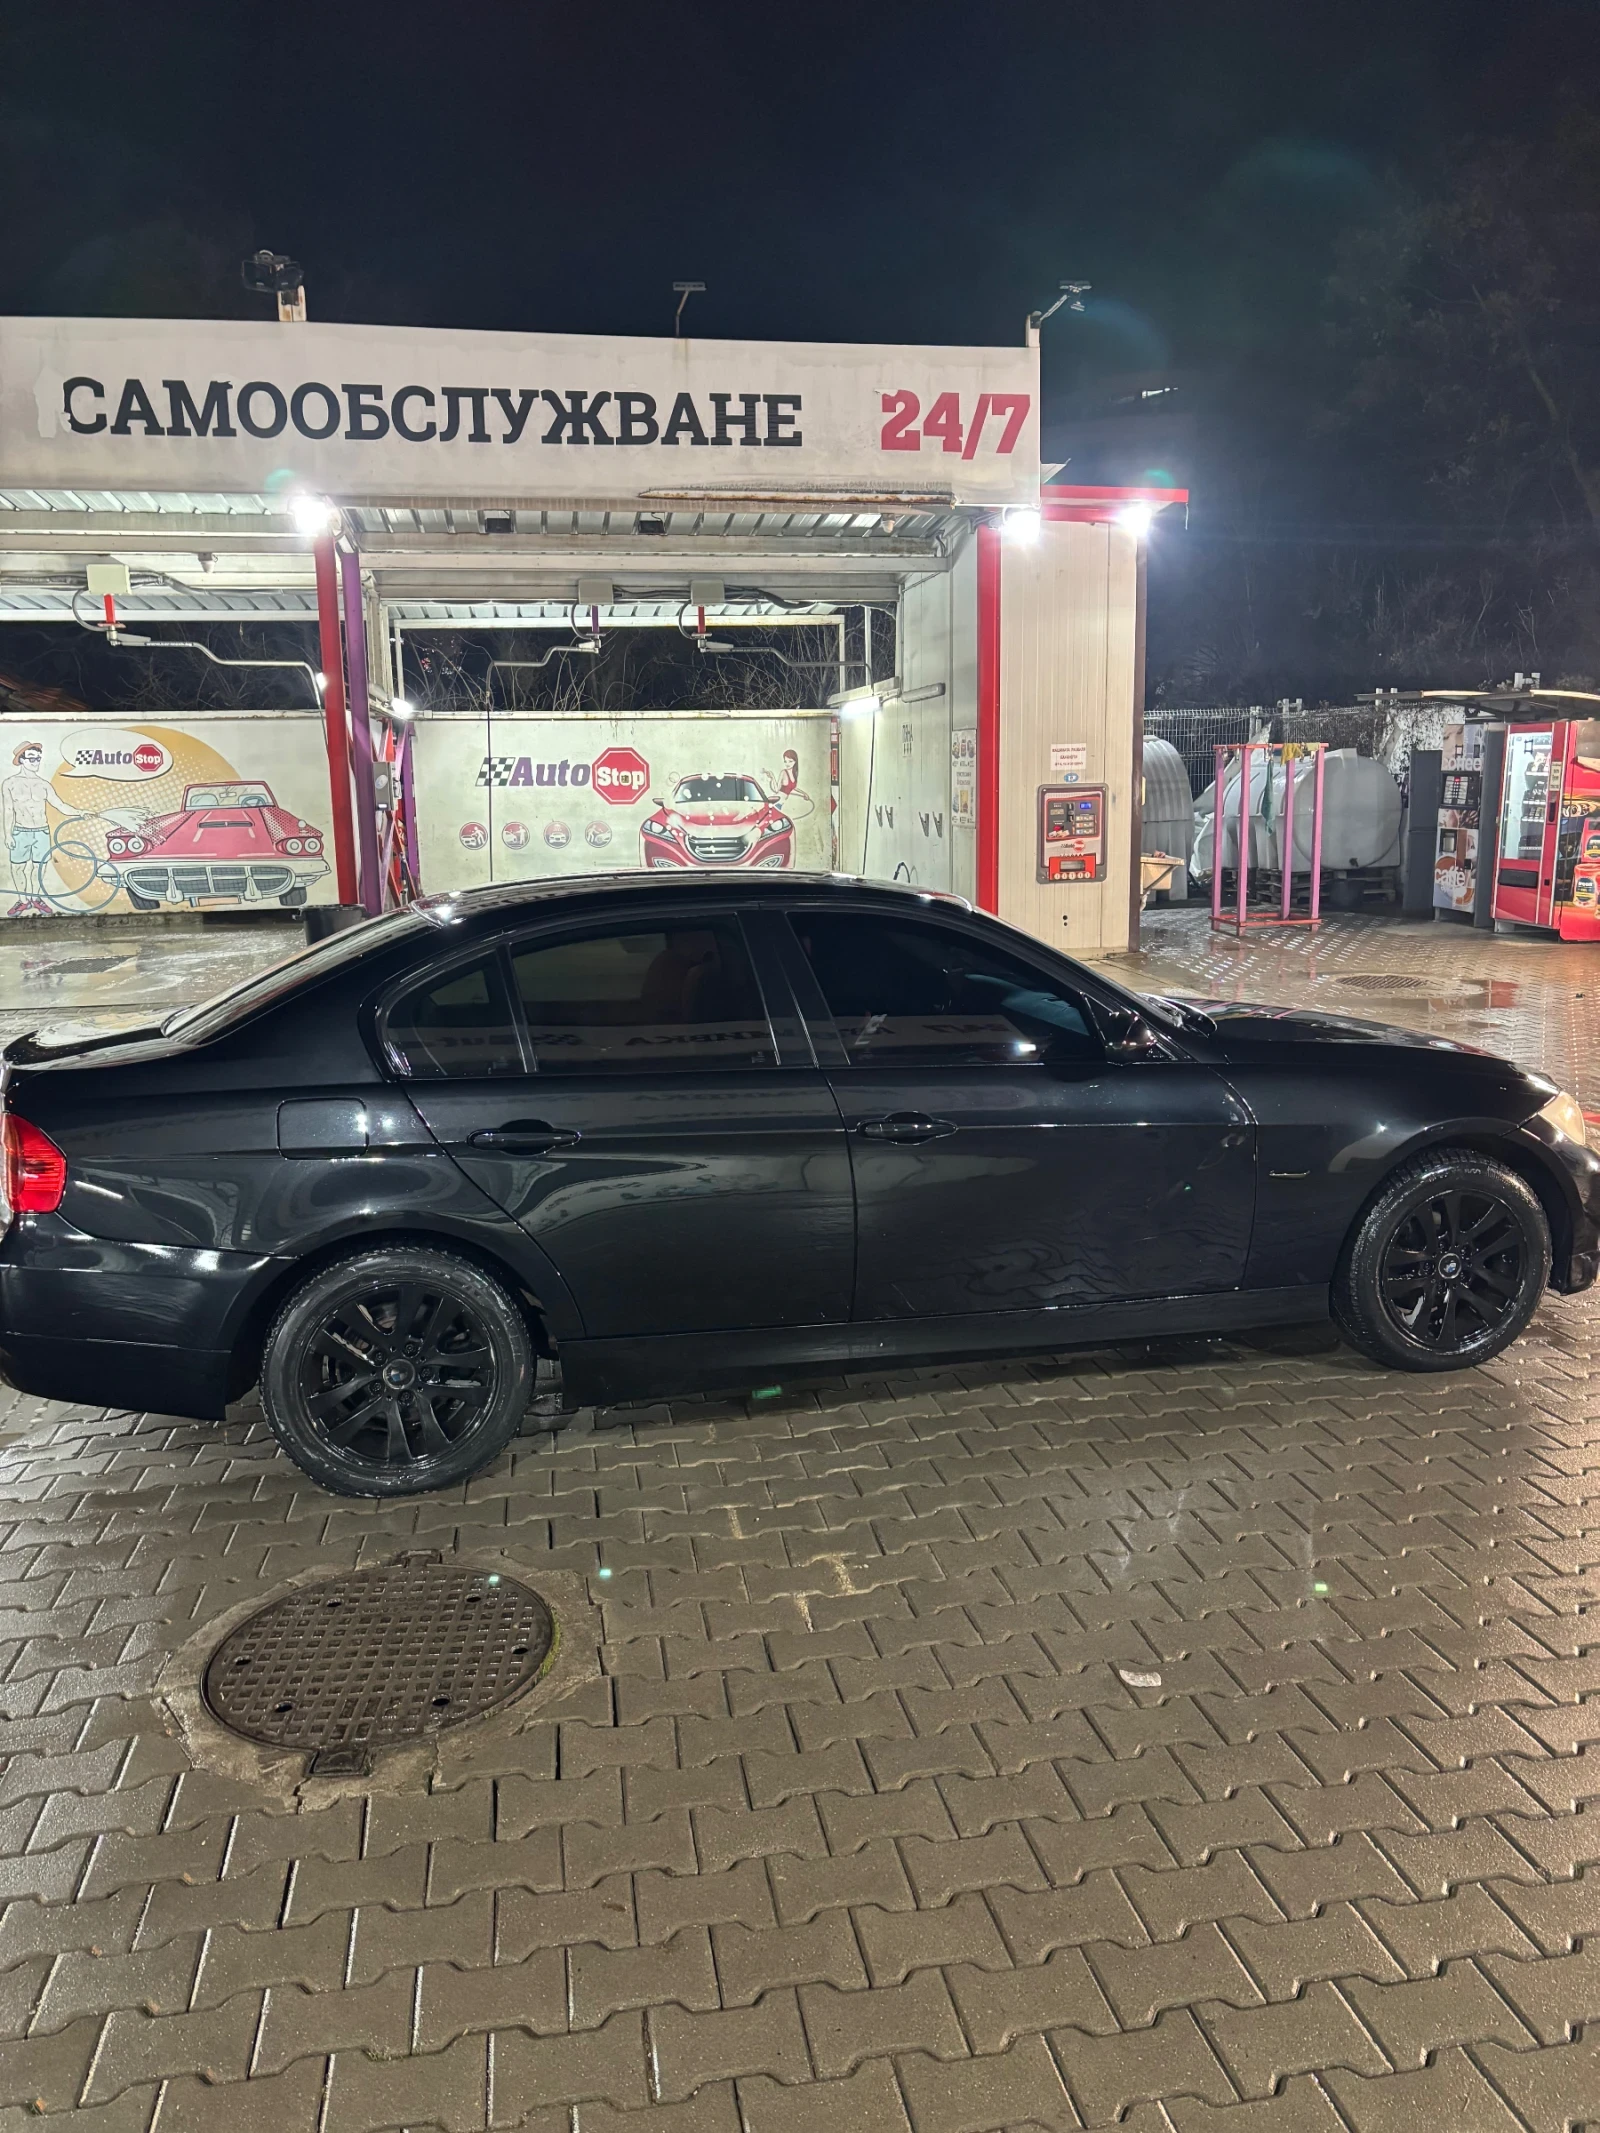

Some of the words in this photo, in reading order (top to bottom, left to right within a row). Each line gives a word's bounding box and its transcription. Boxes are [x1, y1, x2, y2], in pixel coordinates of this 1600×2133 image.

[62, 375, 803, 447] САМООБСЛУЖВАНЕ
[881, 389, 1031, 461] 24/7
[91, 749, 133, 764] Auto
[136, 754, 161, 765] Stop
[509, 757, 591, 786] Auto
[597, 767, 645, 789] Stop
